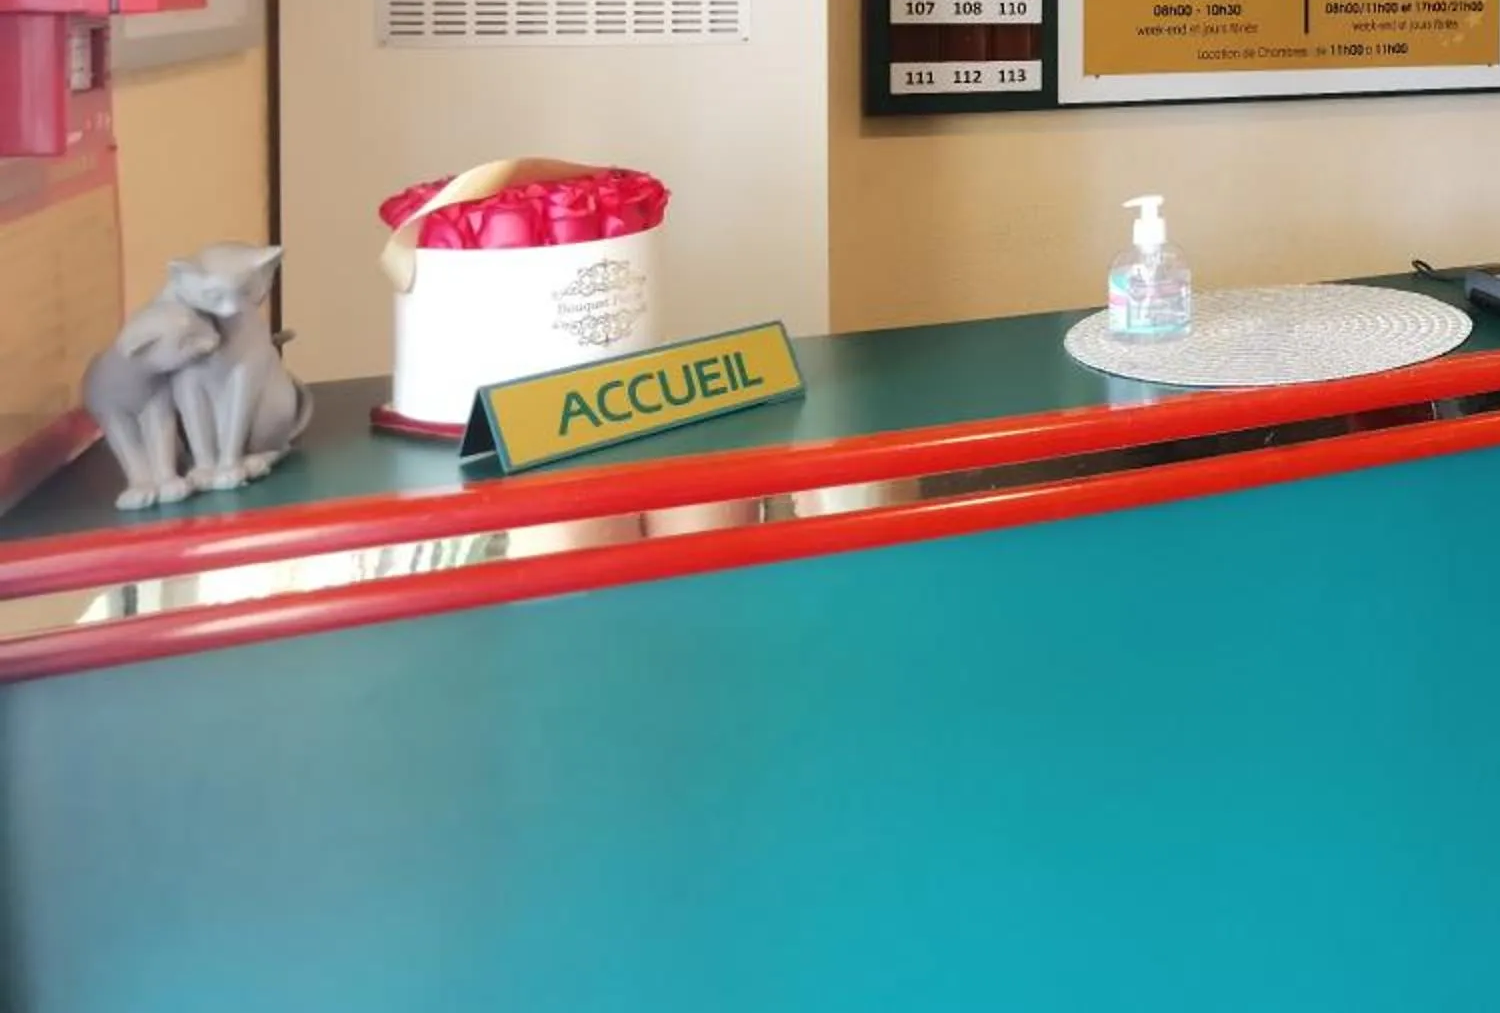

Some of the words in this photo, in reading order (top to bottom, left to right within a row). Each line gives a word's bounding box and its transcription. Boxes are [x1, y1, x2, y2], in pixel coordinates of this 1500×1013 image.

[905, 1, 935, 16] 107
[953, 1, 983, 16] 108
[999, 1, 1027, 16] 110
[1153, 4, 1193, 17] 08h00
[1206, 4, 1242, 16] 10h30
[1329, 43, 1364, 56] 11h00
[906, 71, 935, 85] 111
[953, 70, 982, 84] 112
[998, 68, 1027, 83] 113
[558, 351, 763, 436] ACCUEIL
